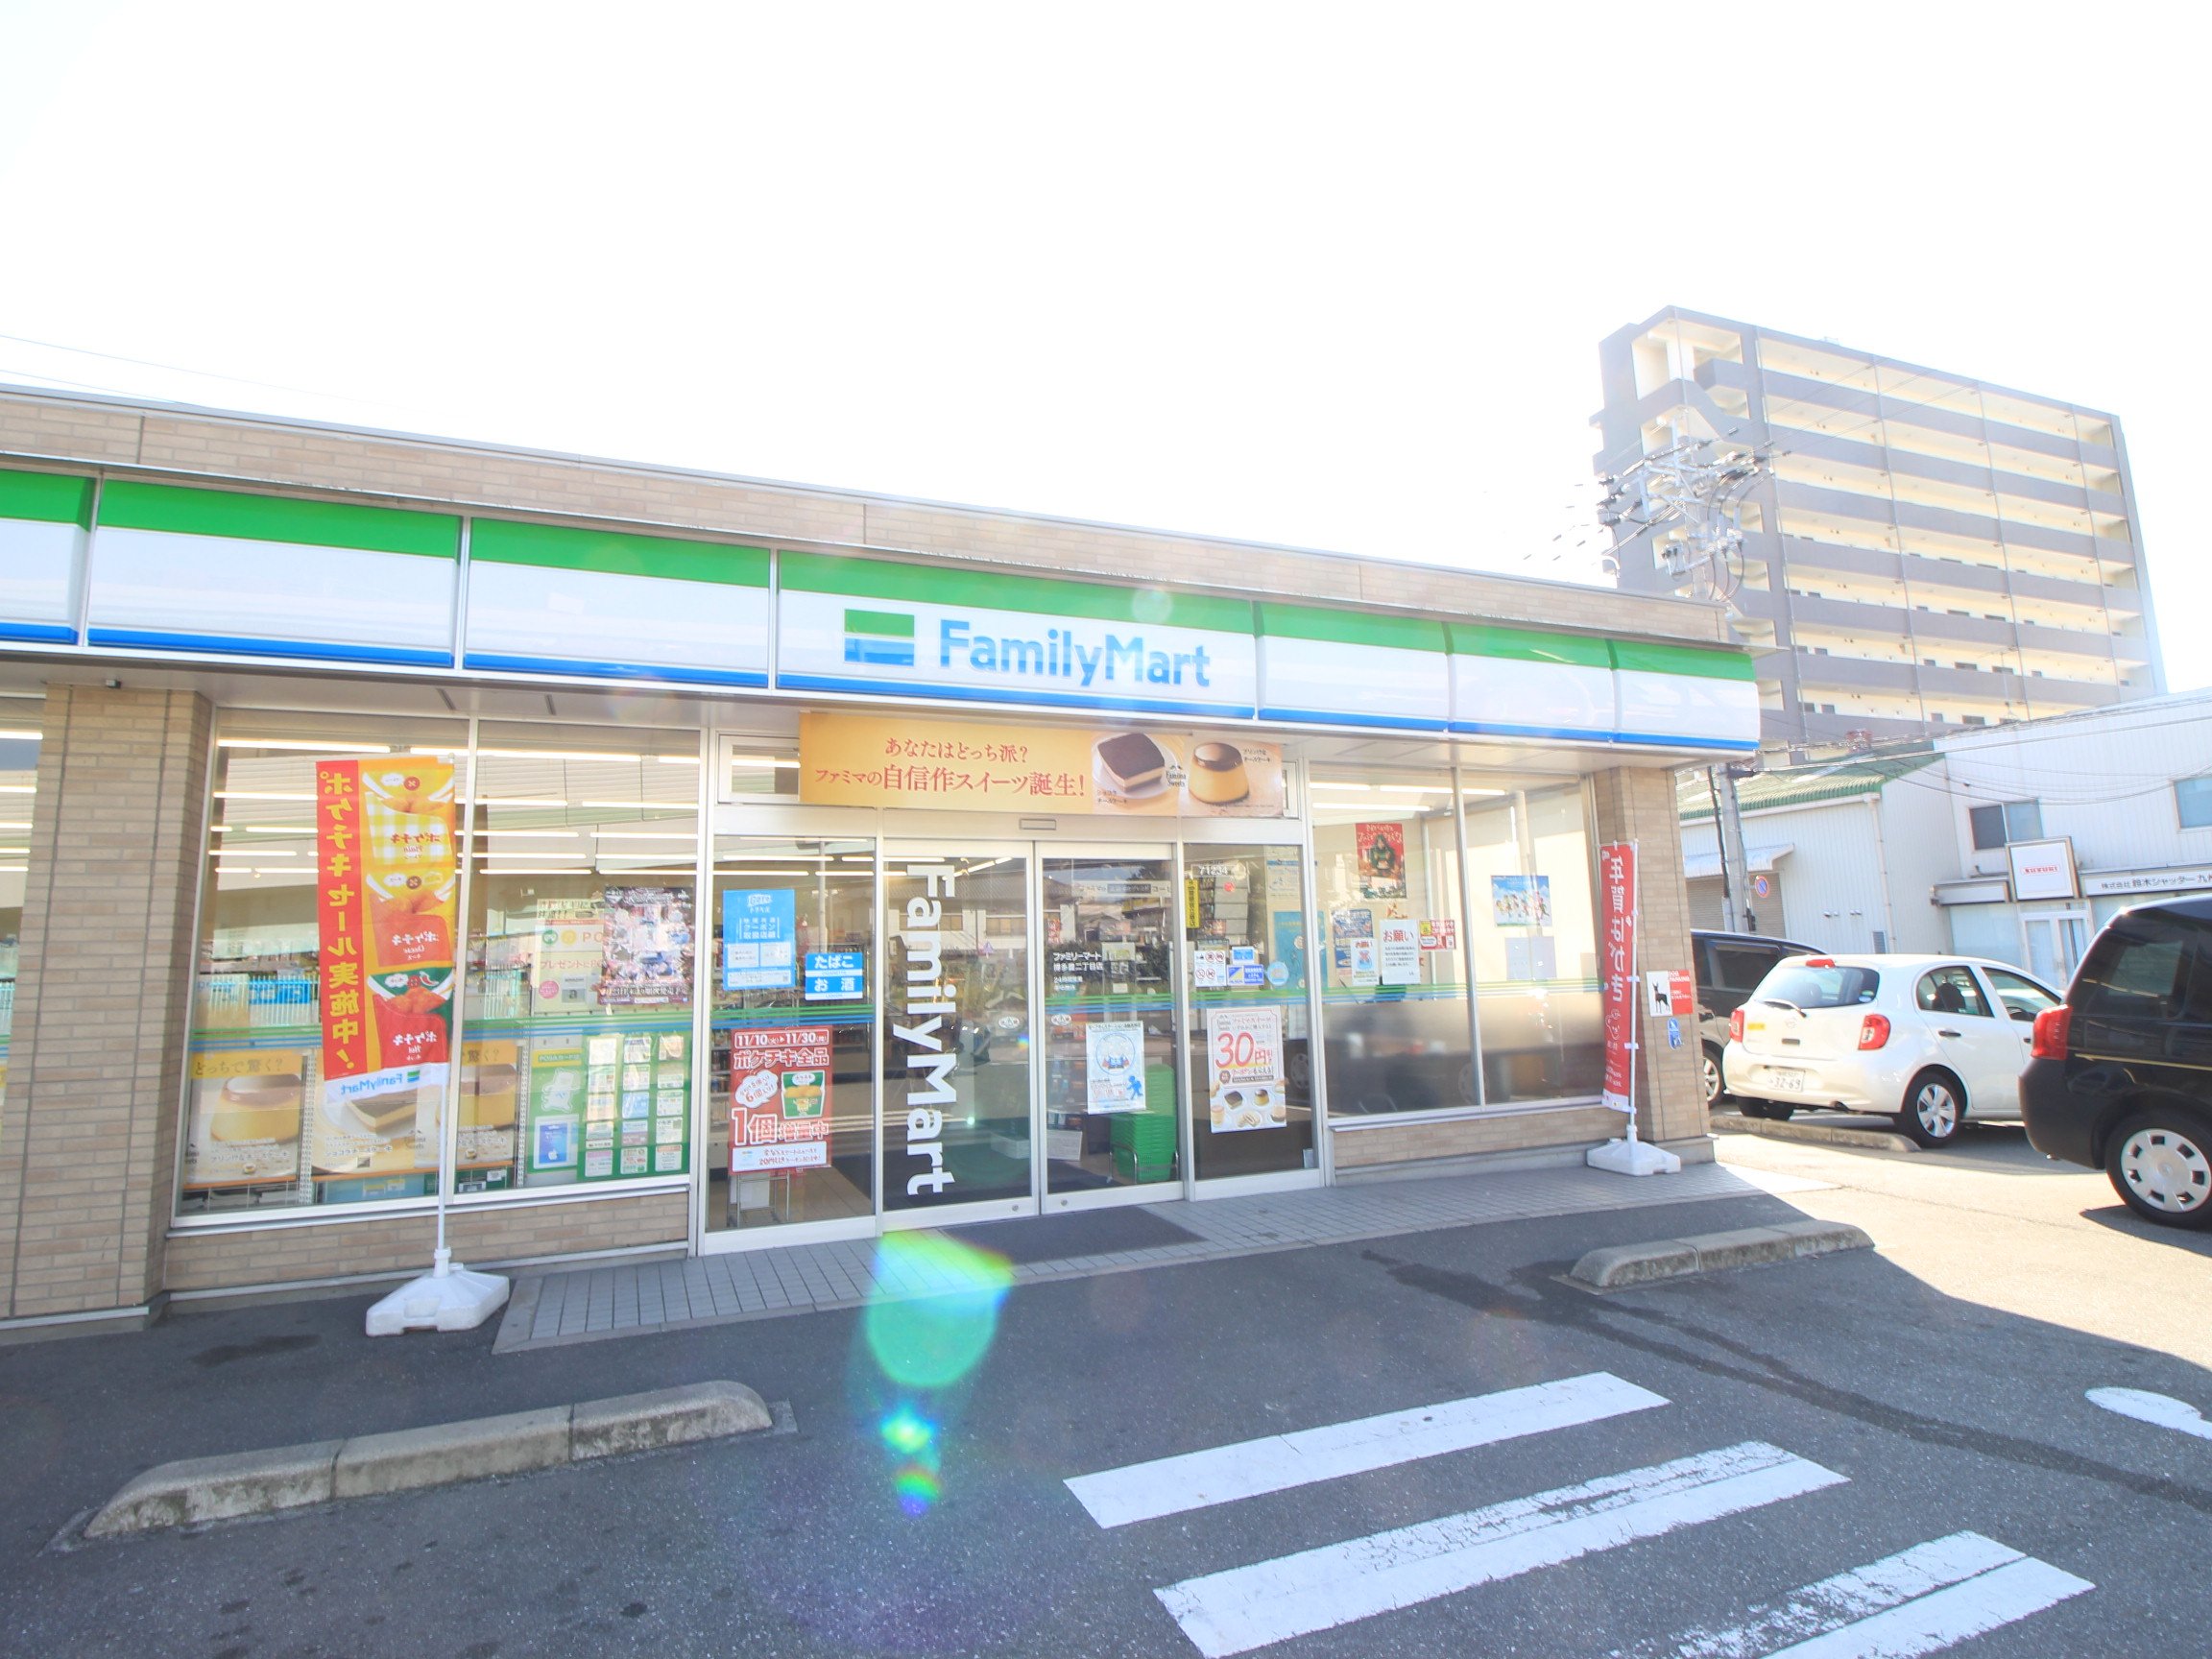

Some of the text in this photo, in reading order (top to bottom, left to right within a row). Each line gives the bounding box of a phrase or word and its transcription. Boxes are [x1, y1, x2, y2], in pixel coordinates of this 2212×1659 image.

[940, 618, 1211, 687] FamilyMart
[885, 737, 1028, 763] あなたはどっち派?
[815, 765, 1085, 797] ファミマの自信作スイーツ誕生!
[1382, 929, 1415, 943] お願い
[1607, 854, 1625, 1002] 年賀はがき
[814, 955, 854, 970] たばこ
[893, 864, 957, 1196] FamilyMart
[733, 1046, 830, 1070] ポケチキ全品
